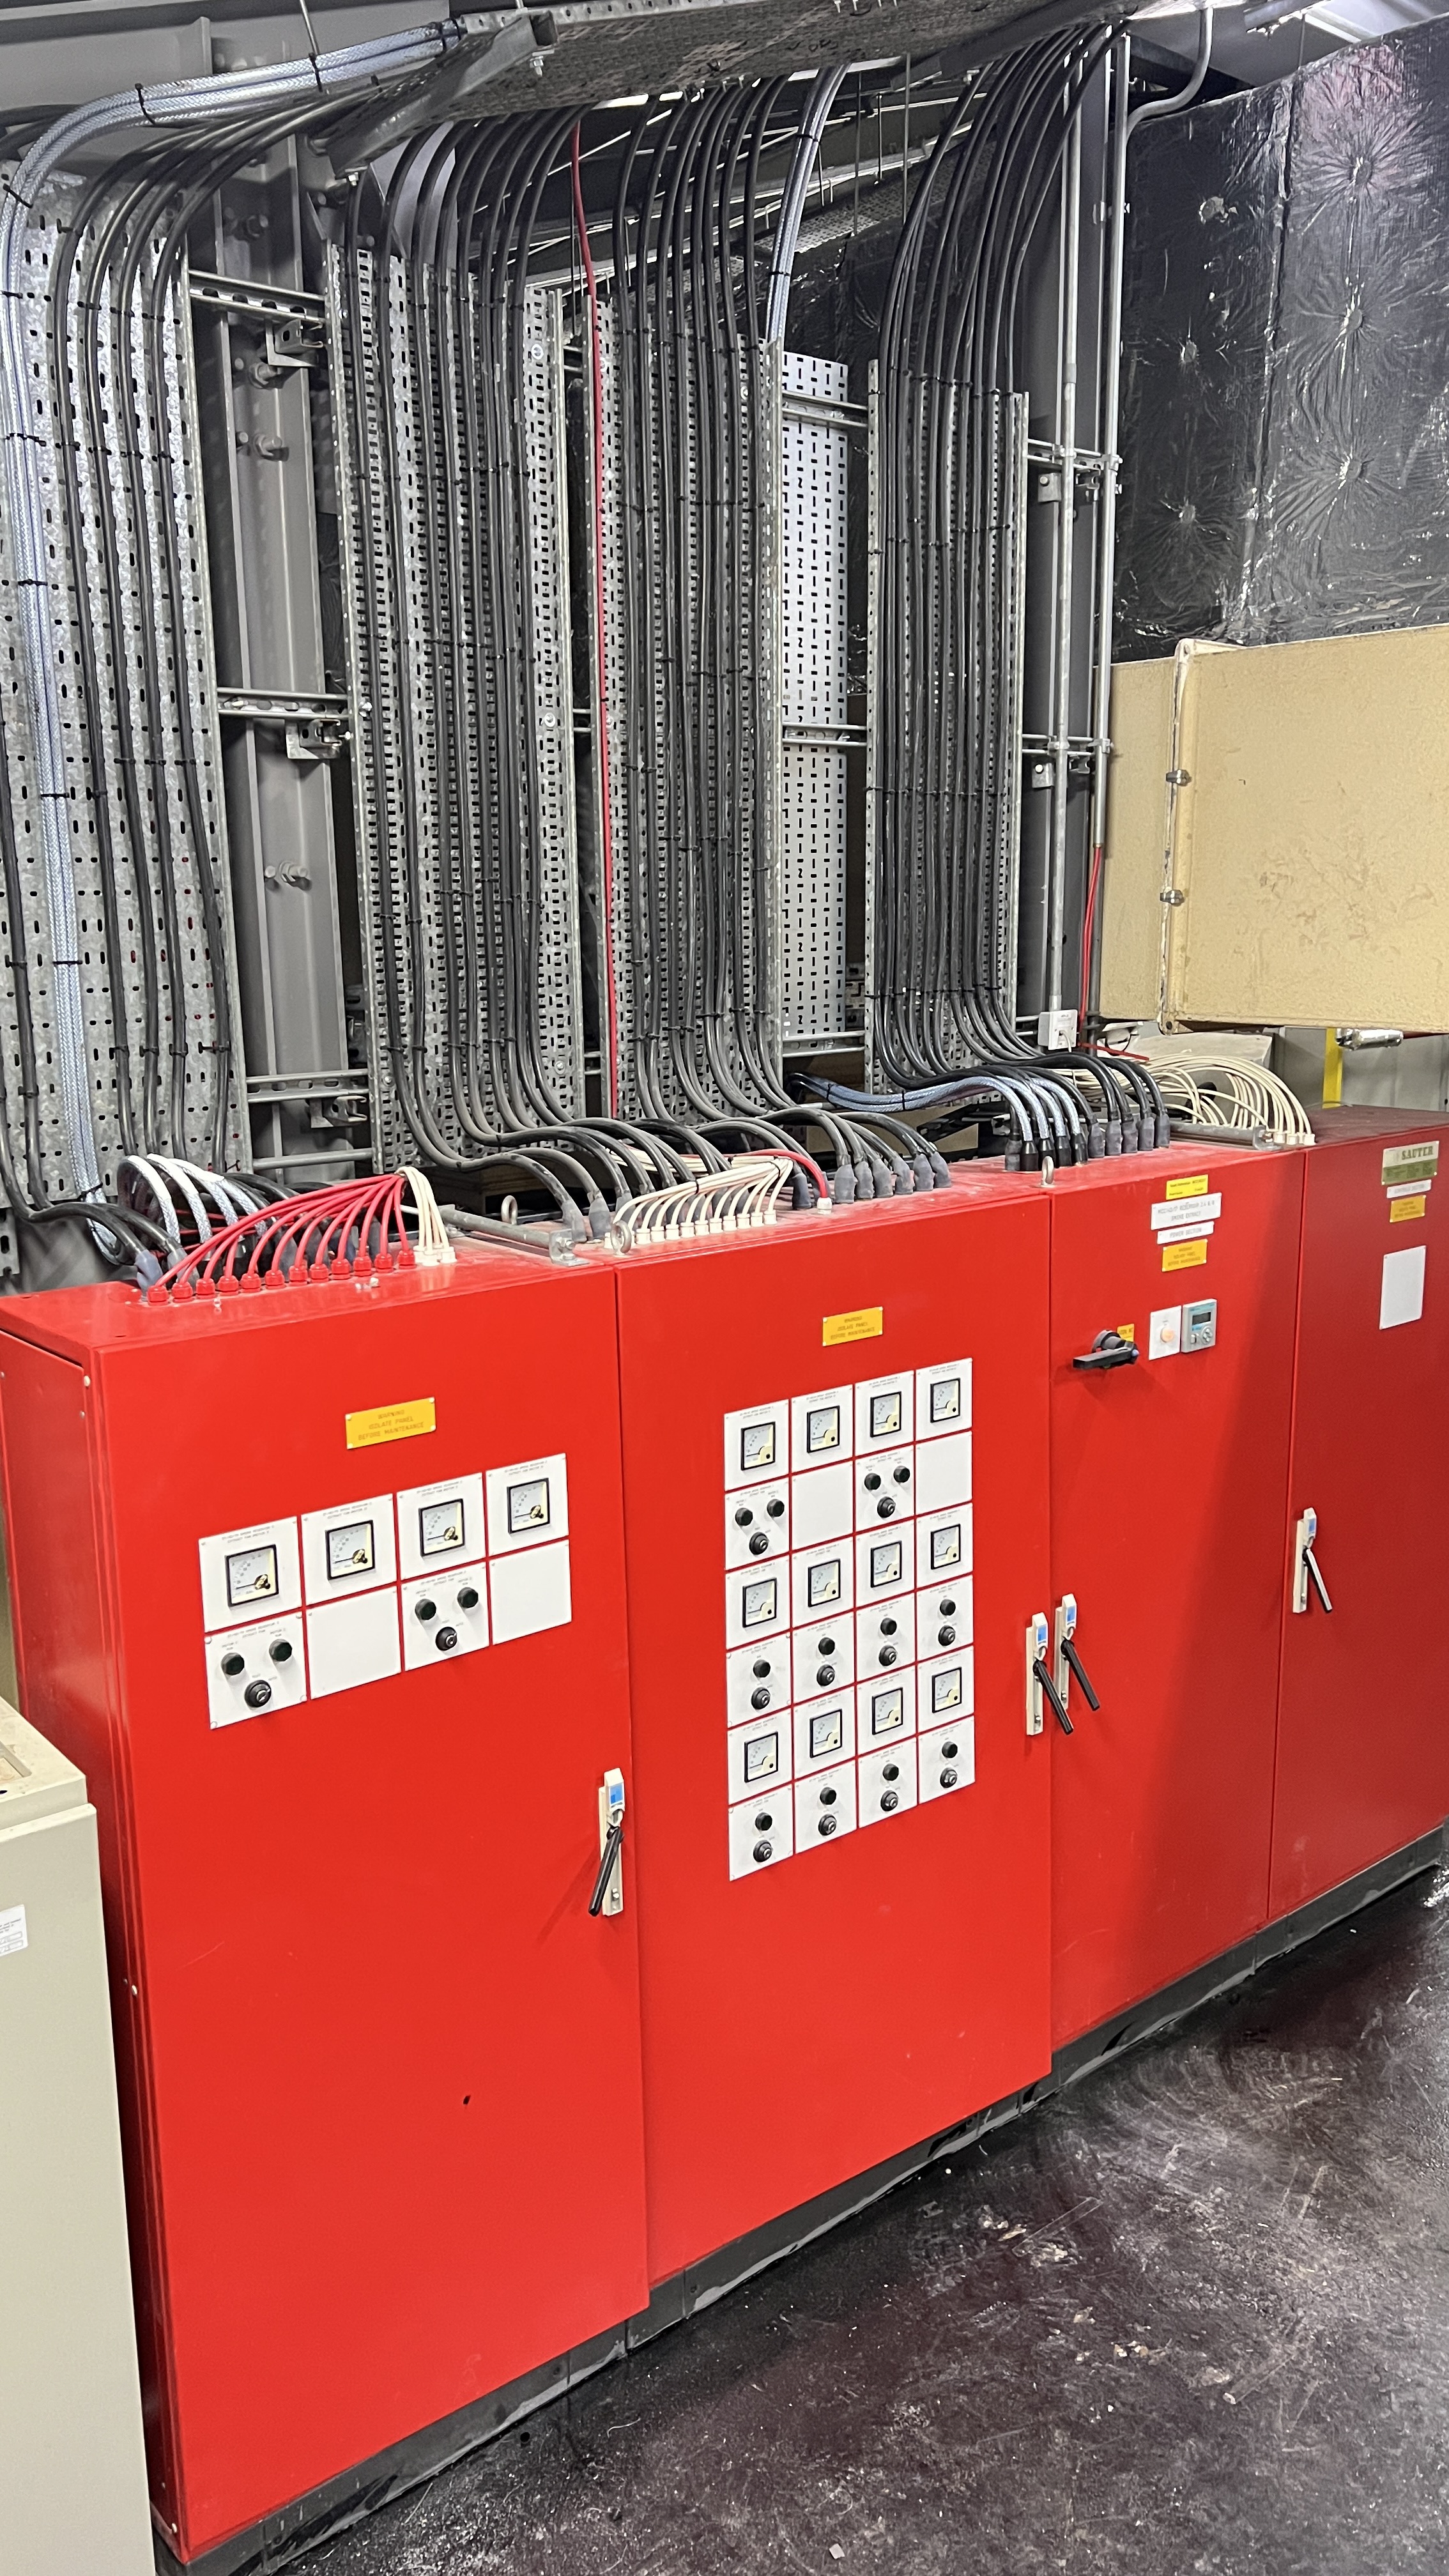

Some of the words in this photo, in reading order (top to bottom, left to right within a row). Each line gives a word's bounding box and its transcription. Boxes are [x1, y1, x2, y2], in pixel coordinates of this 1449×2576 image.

[1402, 1146, 1433, 1160] SAUTER
[378, 1409, 405, 1420] WARNING
[369, 1420, 392, 1430] ISOLATE
[395, 1416, 414, 1424] PANEL
[358, 1430, 381, 1441] BEFORE
[384, 1422, 424, 1434] MAINTENANCE
